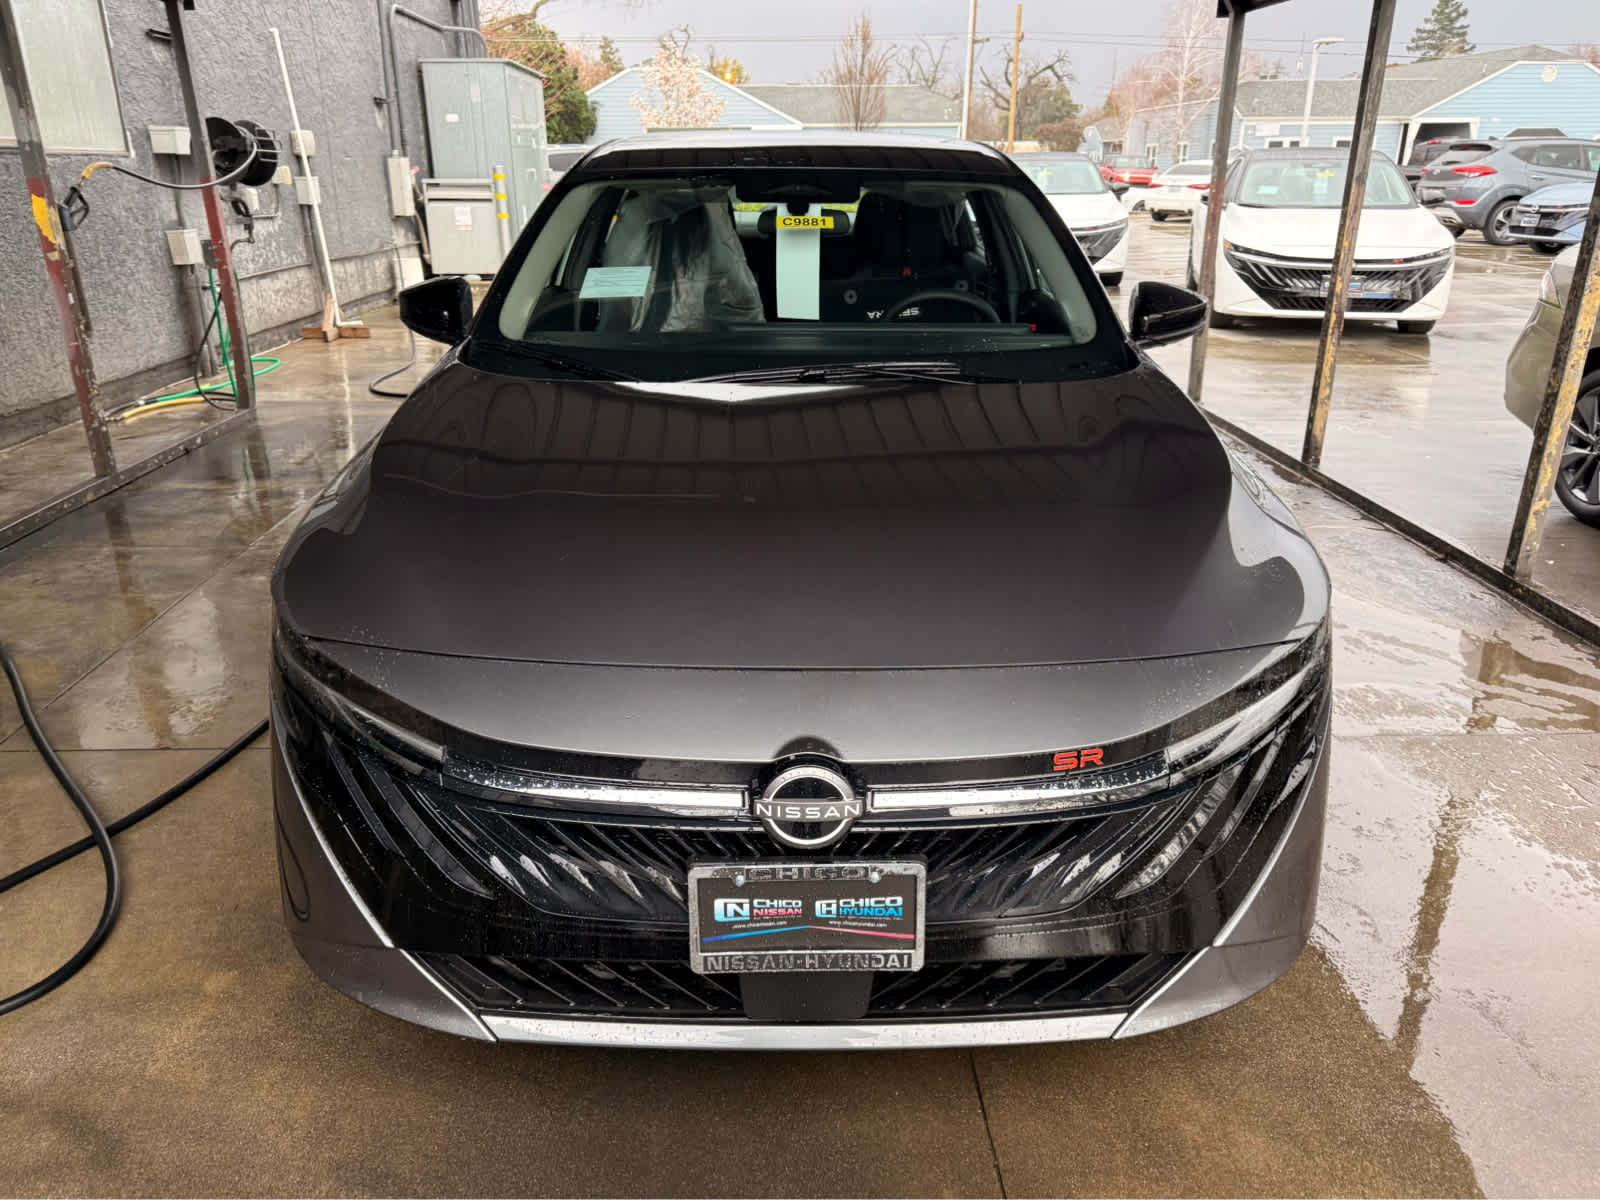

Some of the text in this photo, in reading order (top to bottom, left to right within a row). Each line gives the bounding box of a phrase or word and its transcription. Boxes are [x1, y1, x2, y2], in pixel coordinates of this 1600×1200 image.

[783, 217, 826, 226] C9881
[1053, 748, 1105, 771] SR
[756, 803, 860, 818] NISSAN
[751, 867, 866, 880] CHICO
[753, 899, 802, 908] CHICO
[840, 896, 904, 907] CHICO
[753, 908, 802, 917] NISSAN
[840, 907, 904, 917] HYUNDAI
